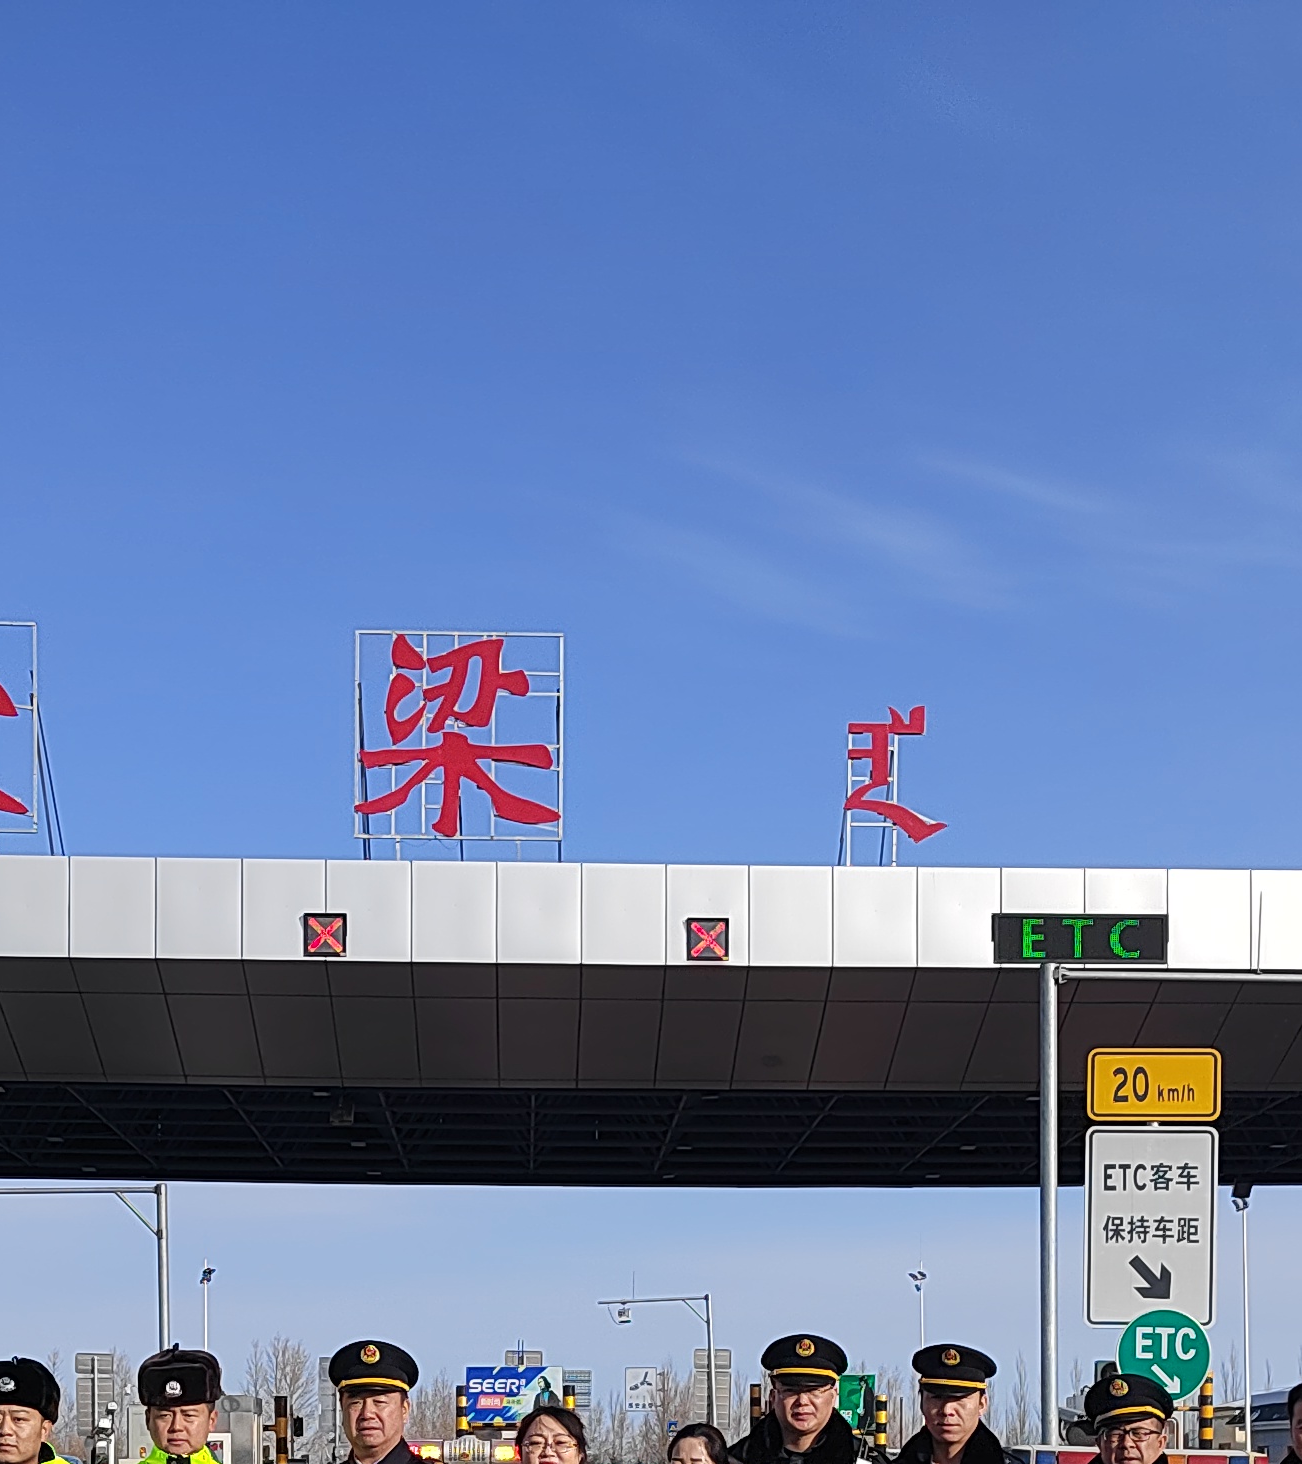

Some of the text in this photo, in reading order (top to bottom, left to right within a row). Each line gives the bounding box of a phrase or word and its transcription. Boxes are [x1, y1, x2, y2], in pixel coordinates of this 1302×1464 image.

[1022, 918, 1139, 958] ETC
[1113, 1066, 1195, 1103] 20 km/h
[1103, 1162, 1200, 1192] ETC客车
[1103, 1215, 1200, 1244] 保持车距
[1135, 1326, 1197, 1360] ETC
[468, 1378, 520, 1393] SEER
